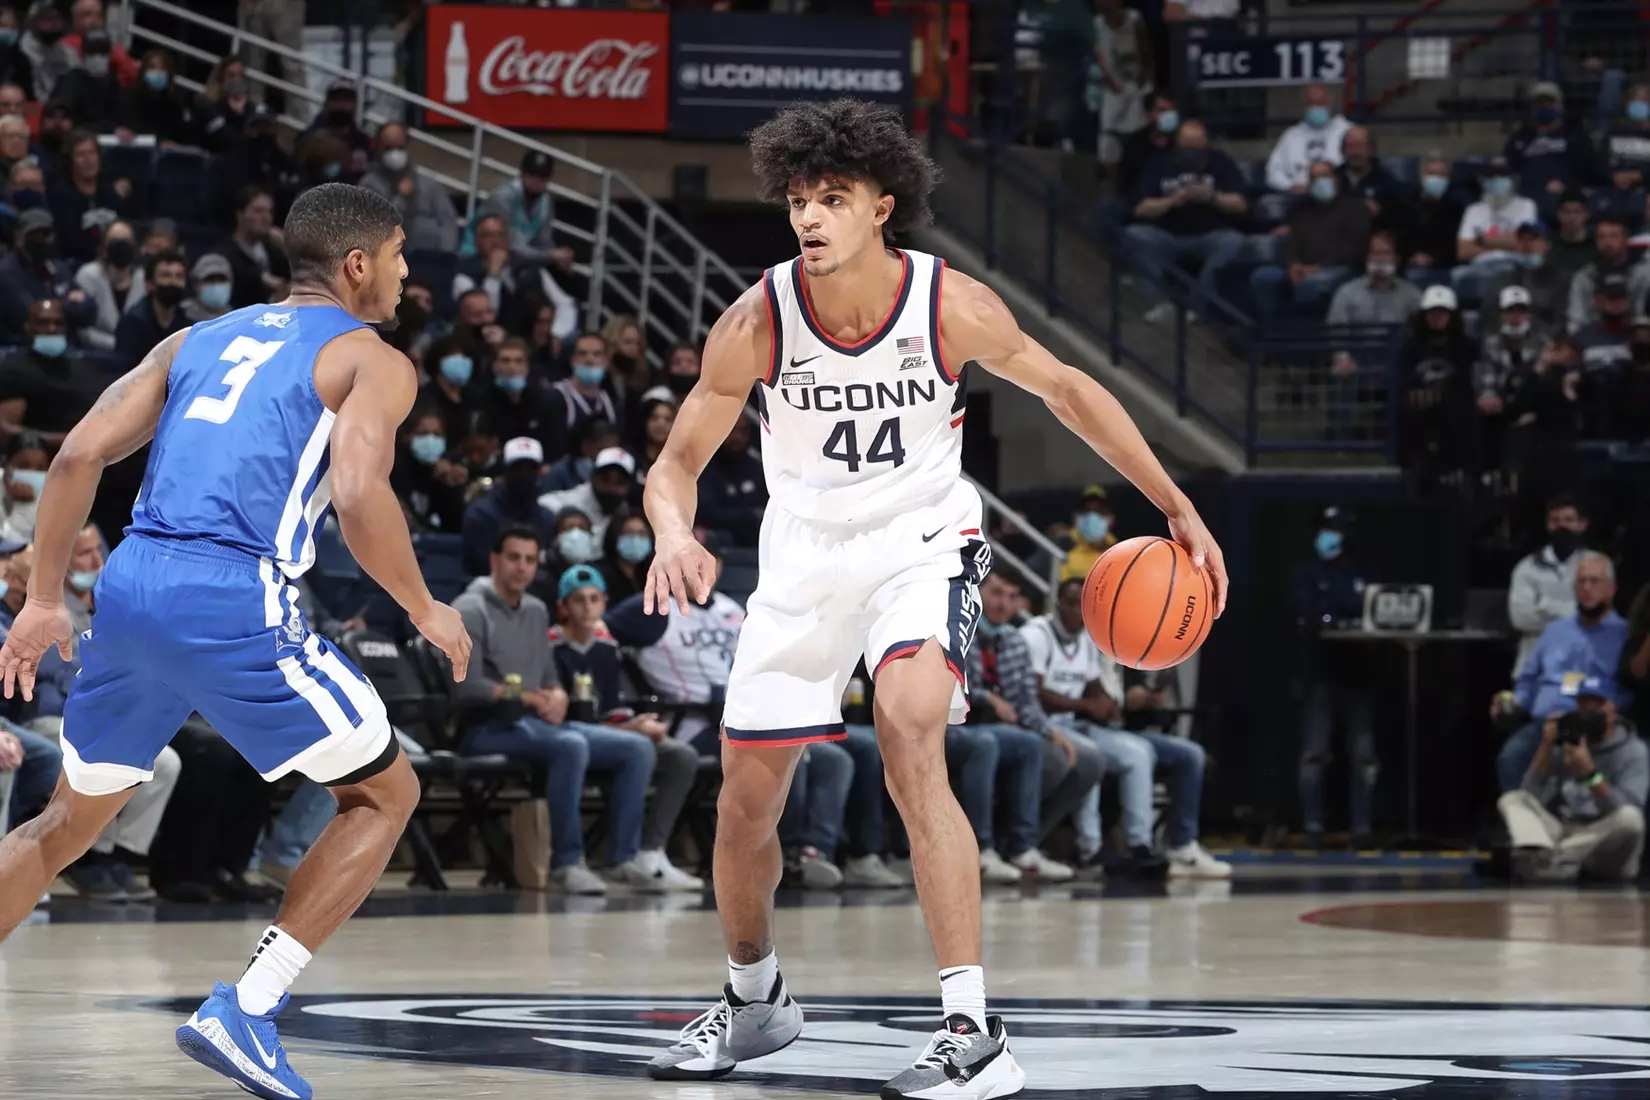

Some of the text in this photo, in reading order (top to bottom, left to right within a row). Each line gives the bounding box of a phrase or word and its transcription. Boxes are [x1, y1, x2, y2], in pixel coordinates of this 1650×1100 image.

[680, 63, 902, 92] @UCONNHUSKIES
[1202, 40, 1345, 80] SEC 113
[184, 335, 286, 425] 3
[781, 379, 936, 412] UCONN
[822, 416, 906, 473] 44
[1174, 595, 1196, 641] UCONN
